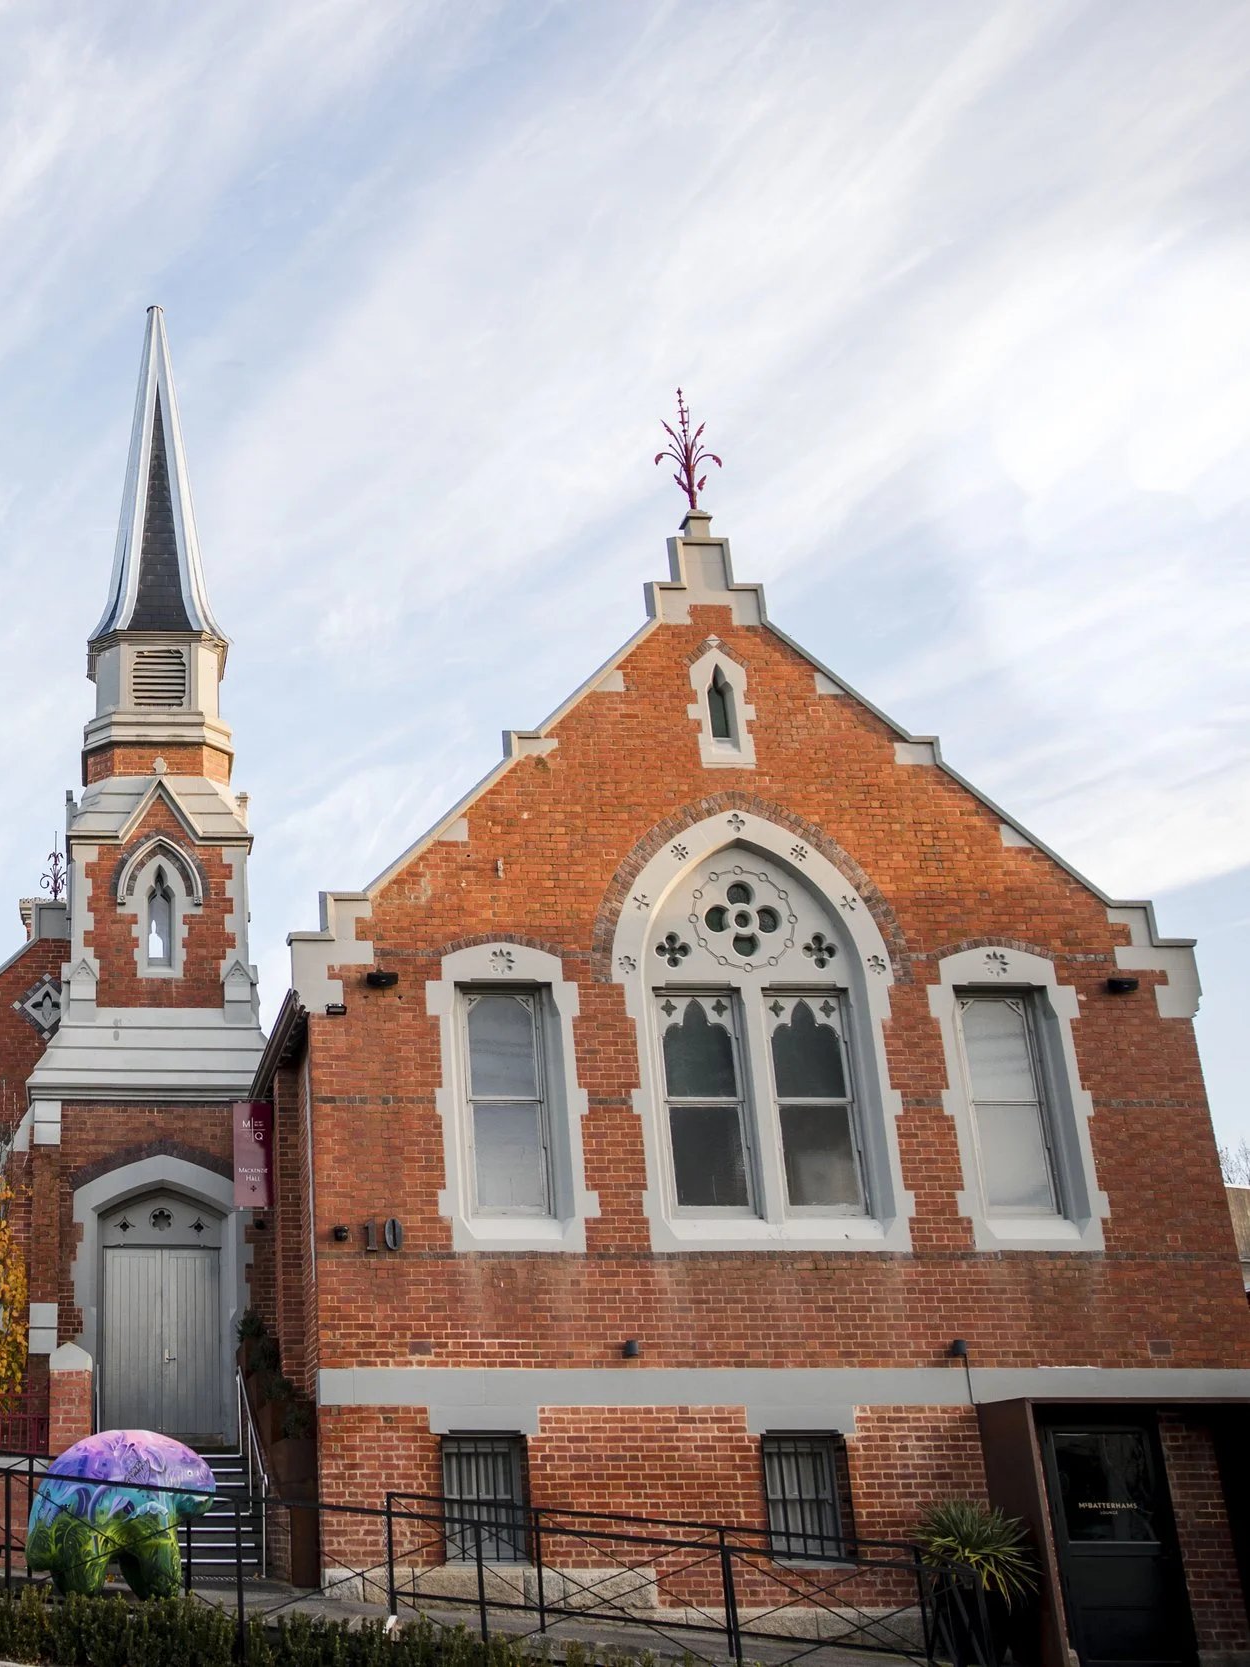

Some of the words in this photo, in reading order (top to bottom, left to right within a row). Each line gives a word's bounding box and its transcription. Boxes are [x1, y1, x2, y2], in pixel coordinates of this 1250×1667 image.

[242, 1120, 251, 1128] M
[254, 1132, 264, 1140] Q
[365, 1216, 403, 1251] 10
